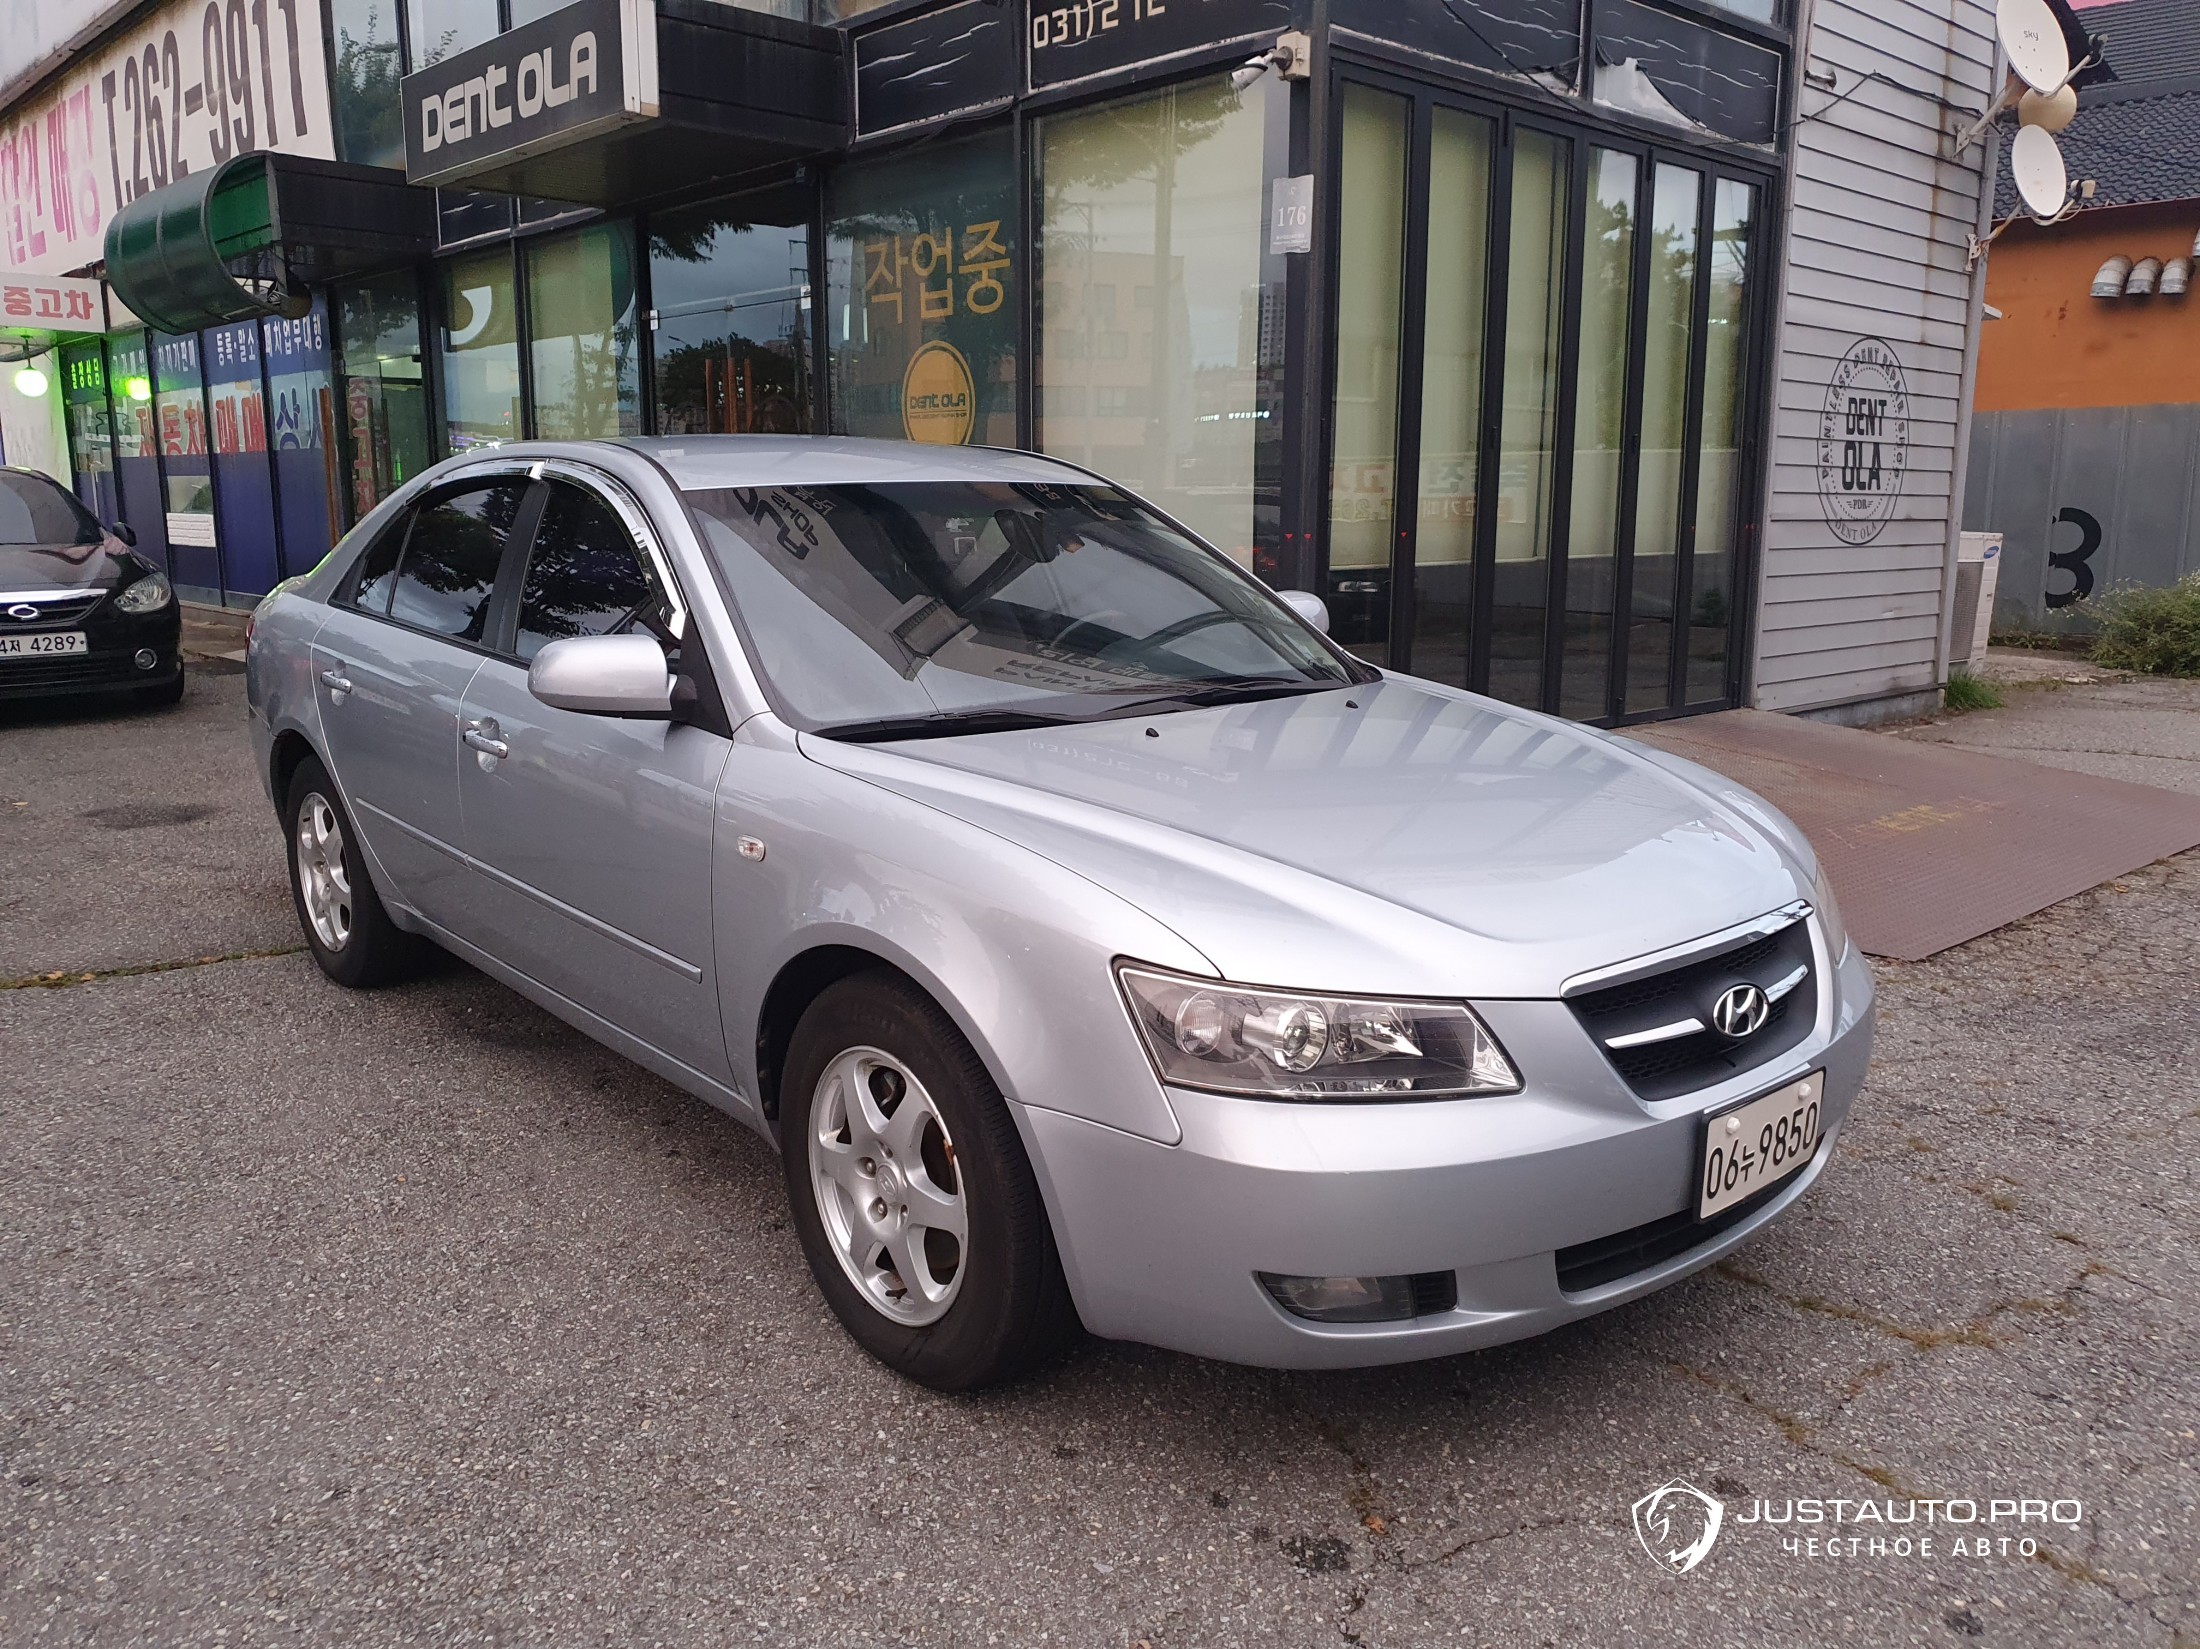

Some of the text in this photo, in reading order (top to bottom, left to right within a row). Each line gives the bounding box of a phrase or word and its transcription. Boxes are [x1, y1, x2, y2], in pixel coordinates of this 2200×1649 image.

[517, 31, 597, 118] OLA
[47, 84, 101, 243] 매장
[1277, 205, 1307, 227] 176
[865, 220, 1011, 324] 작업중
[3, 285, 94, 321] 중고차
[941, 393, 966, 408] OLA
[1846, 396, 1887, 435] DENT
[1841, 440, 1881, 491] OLA
[1835, 519, 1877, 541] DENT OLA
[30, 636, 76, 652] 4289
